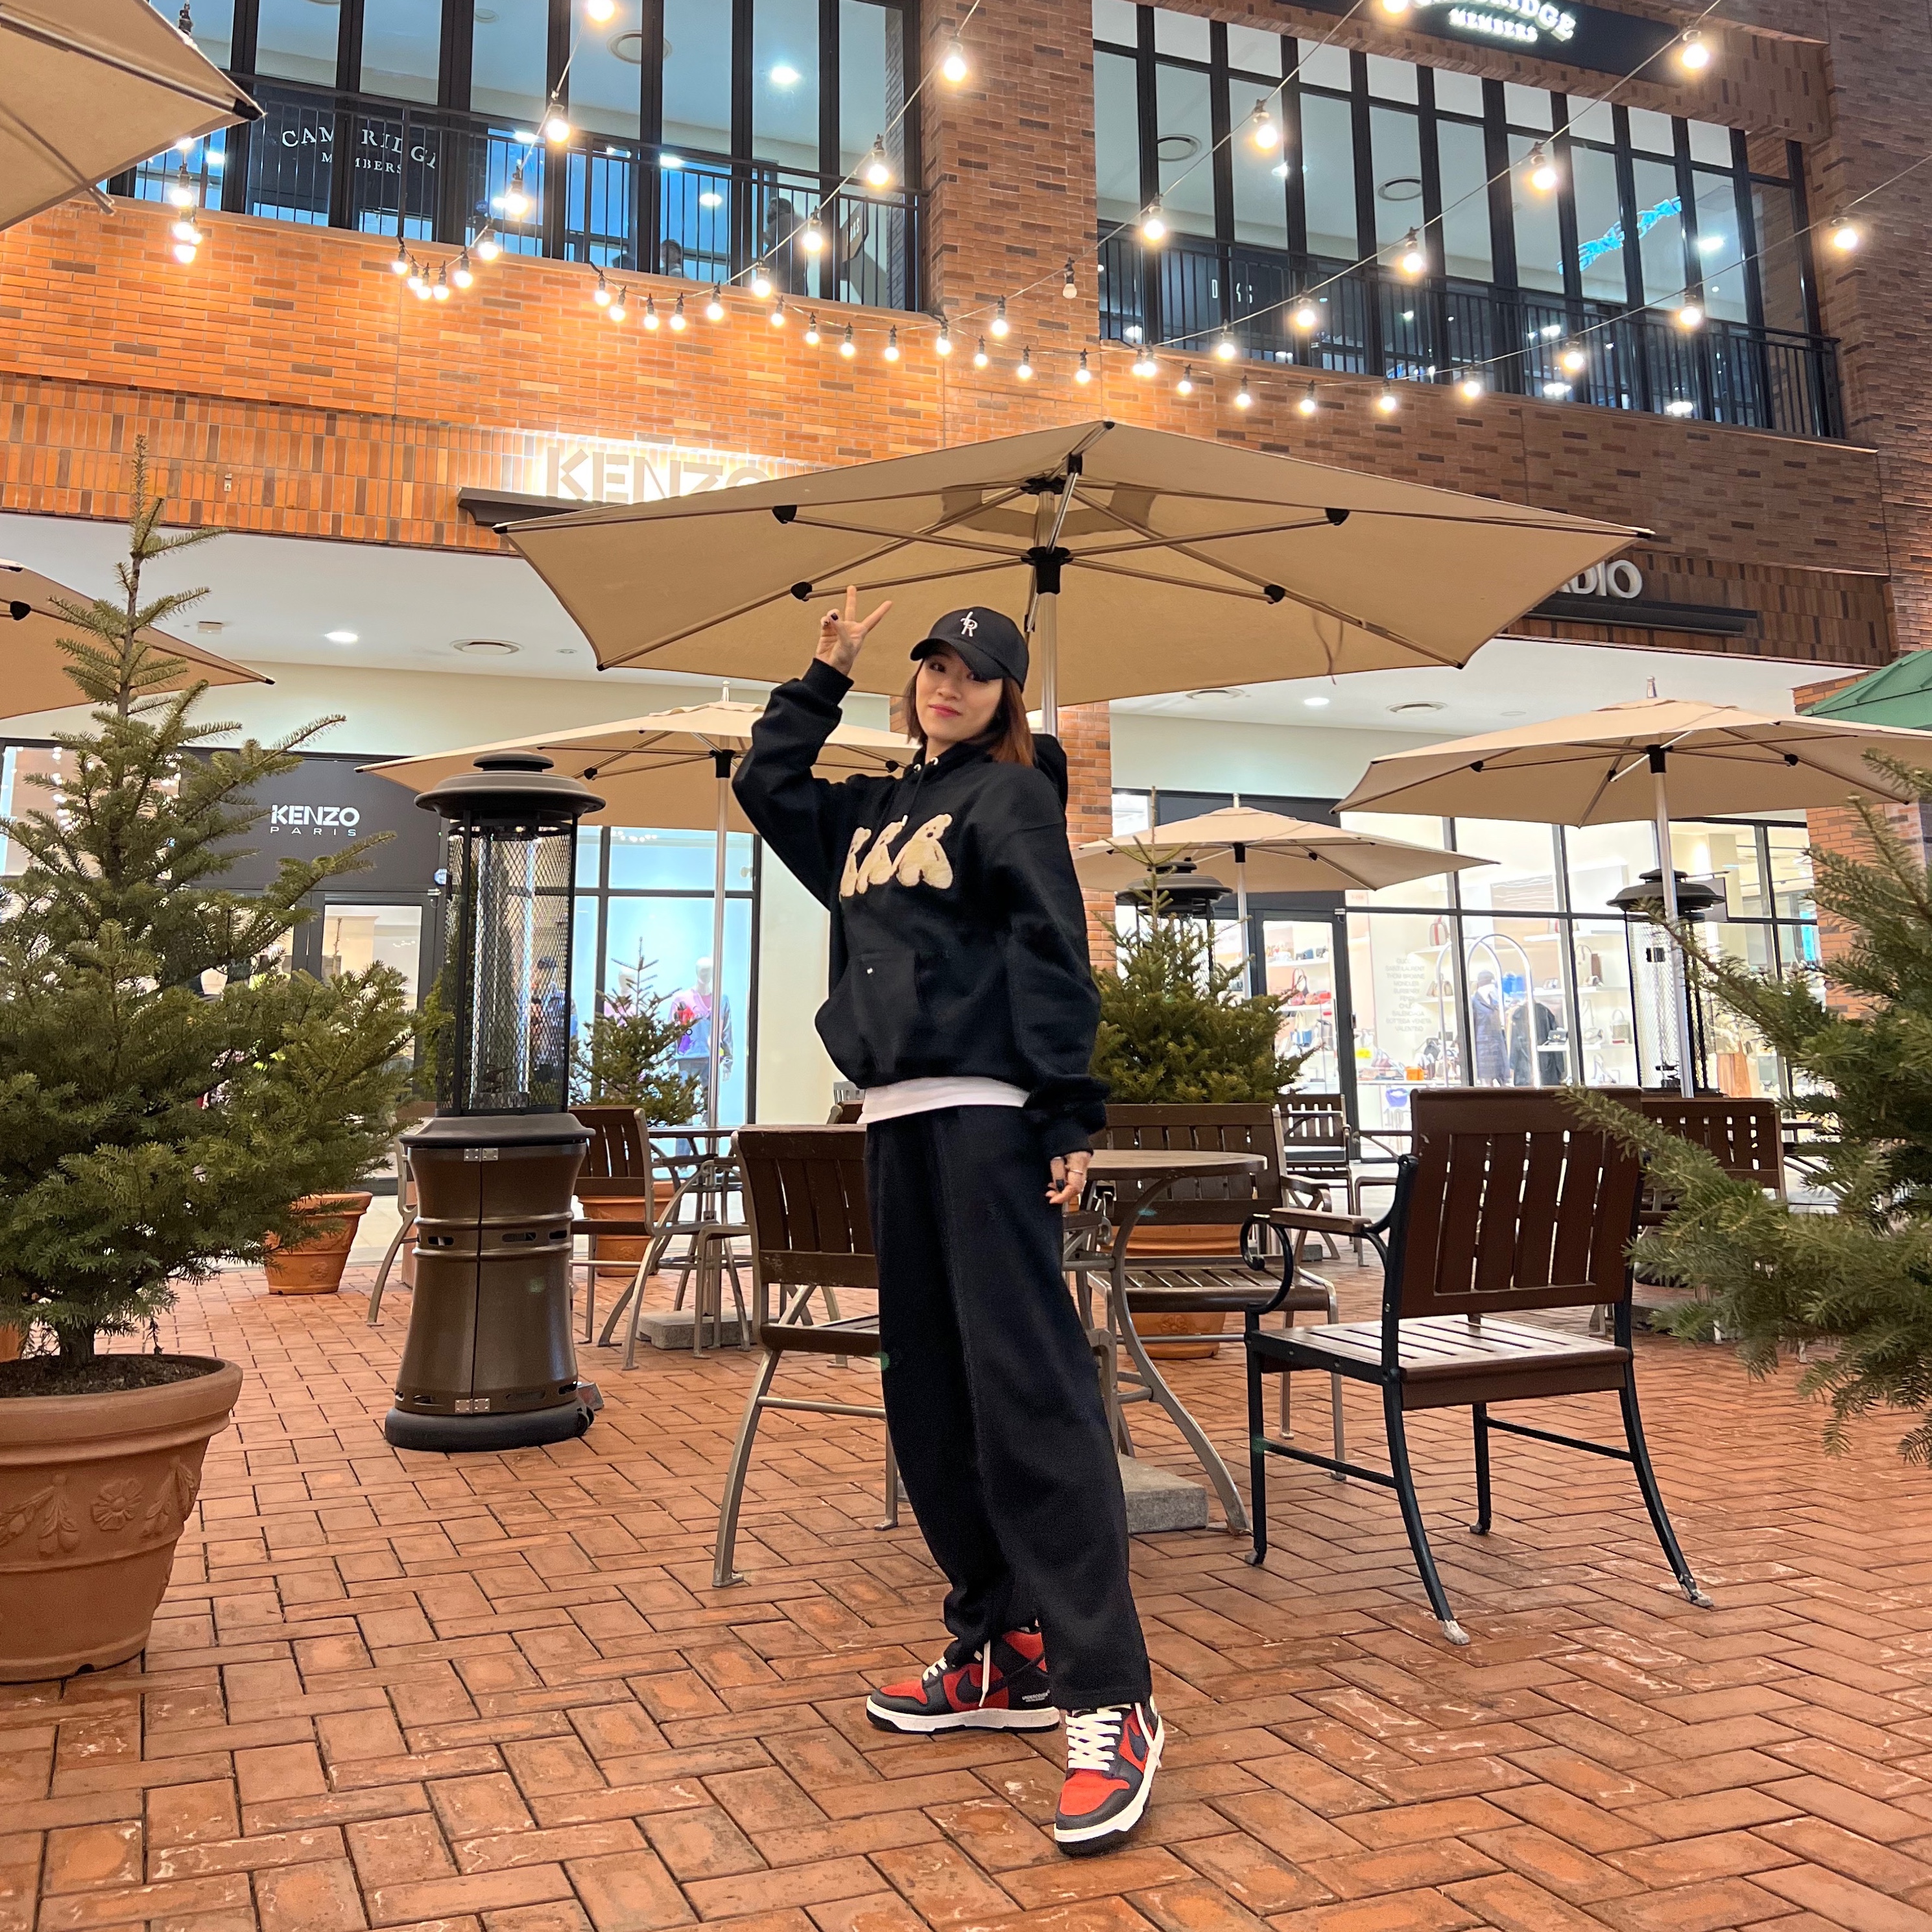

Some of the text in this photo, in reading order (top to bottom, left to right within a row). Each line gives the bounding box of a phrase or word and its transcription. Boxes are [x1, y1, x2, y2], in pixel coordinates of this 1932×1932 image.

[281, 126, 435, 169] CAMRIDG
[1558, 559, 1643, 599] DIO
[270, 804, 360, 827] KENZO
[270, 826, 357, 837] PARIS
